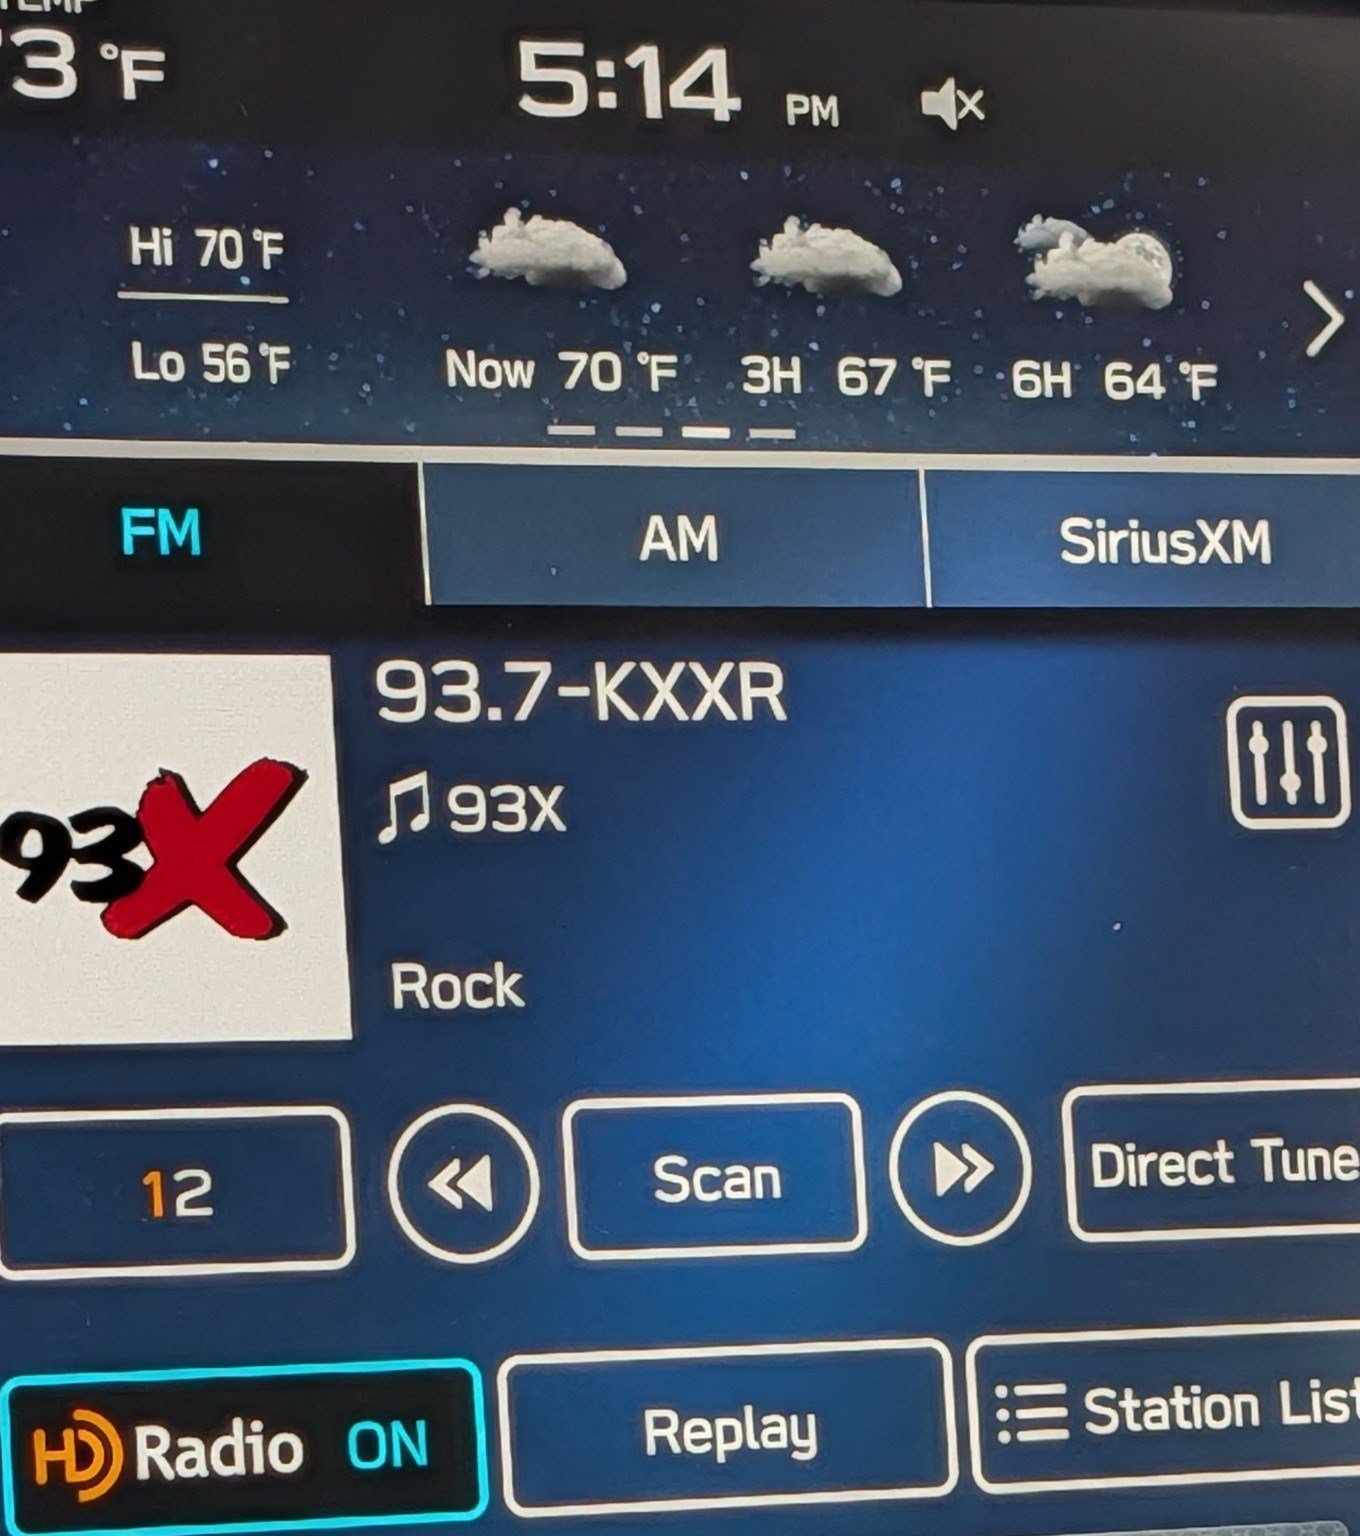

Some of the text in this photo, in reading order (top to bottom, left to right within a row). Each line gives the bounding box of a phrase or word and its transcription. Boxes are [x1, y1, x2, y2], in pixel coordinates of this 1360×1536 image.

[517, 41, 840, 127] 5:14 PM
[131, 226, 173, 267] Hi
[132, 341, 185, 382] Lo
[445, 350, 535, 391] Now
[742, 355, 802, 394] 3H
[1012, 359, 1071, 398] 6H
[121, 508, 202, 556] FM
[640, 514, 718, 563] AM
[1059, 517, 1273, 567] SiriusXM
[374, 660, 788, 724] 93.7-KXXR
[448, 784, 567, 832] 93X
[392, 962, 525, 1009] Rock
[652, 1155, 781, 1202] Scan
[1091, 1138, 1360, 1189] Direct Tune
[1084, 1386, 1260, 1434] Station
[135, 1419, 305, 1481] Radio
[348, 1420, 428, 1469] ON
[644, 1406, 819, 1464] Replay
